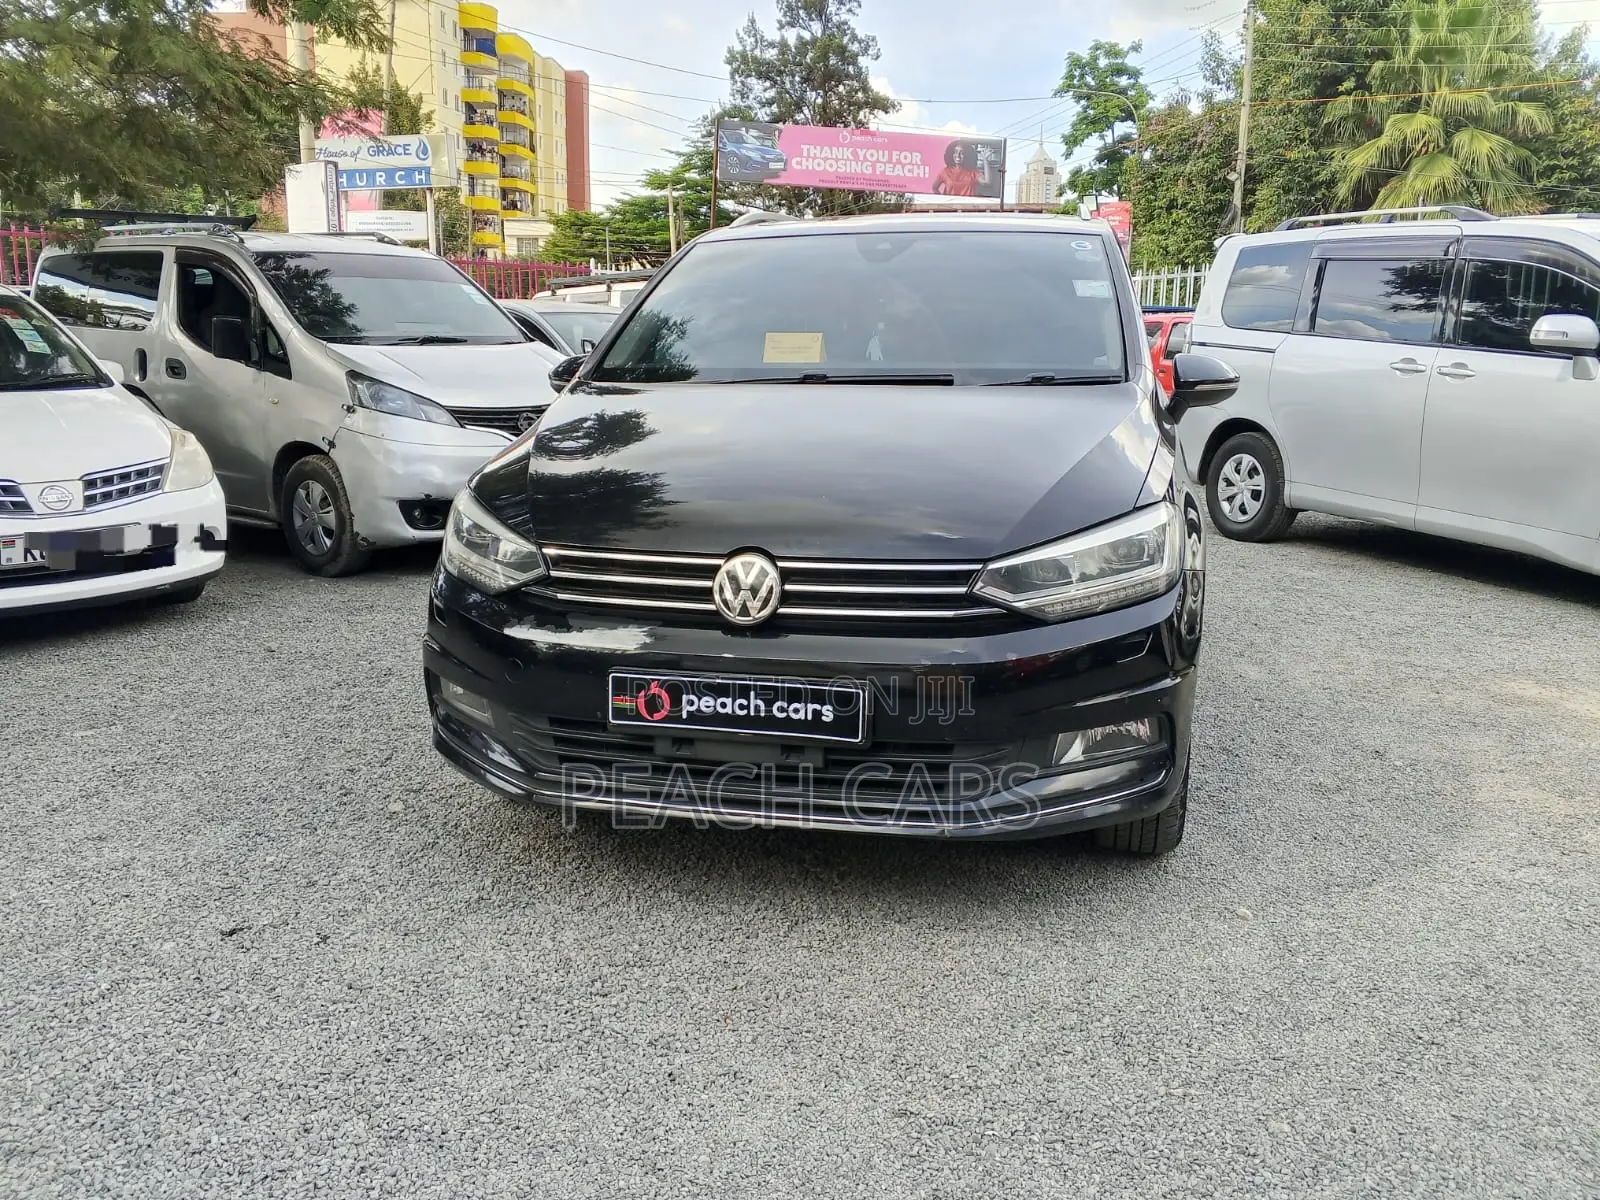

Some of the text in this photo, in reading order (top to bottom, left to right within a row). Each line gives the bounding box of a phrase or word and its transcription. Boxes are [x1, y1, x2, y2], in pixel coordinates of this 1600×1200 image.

[315, 143, 412, 162] House of GRACE
[800, 144, 922, 165] THANK YOU FOR
[791, 157, 930, 178] CHOOSING PEACH!
[338, 170, 426, 187] HURCH
[681, 690, 834, 723] peach cars
